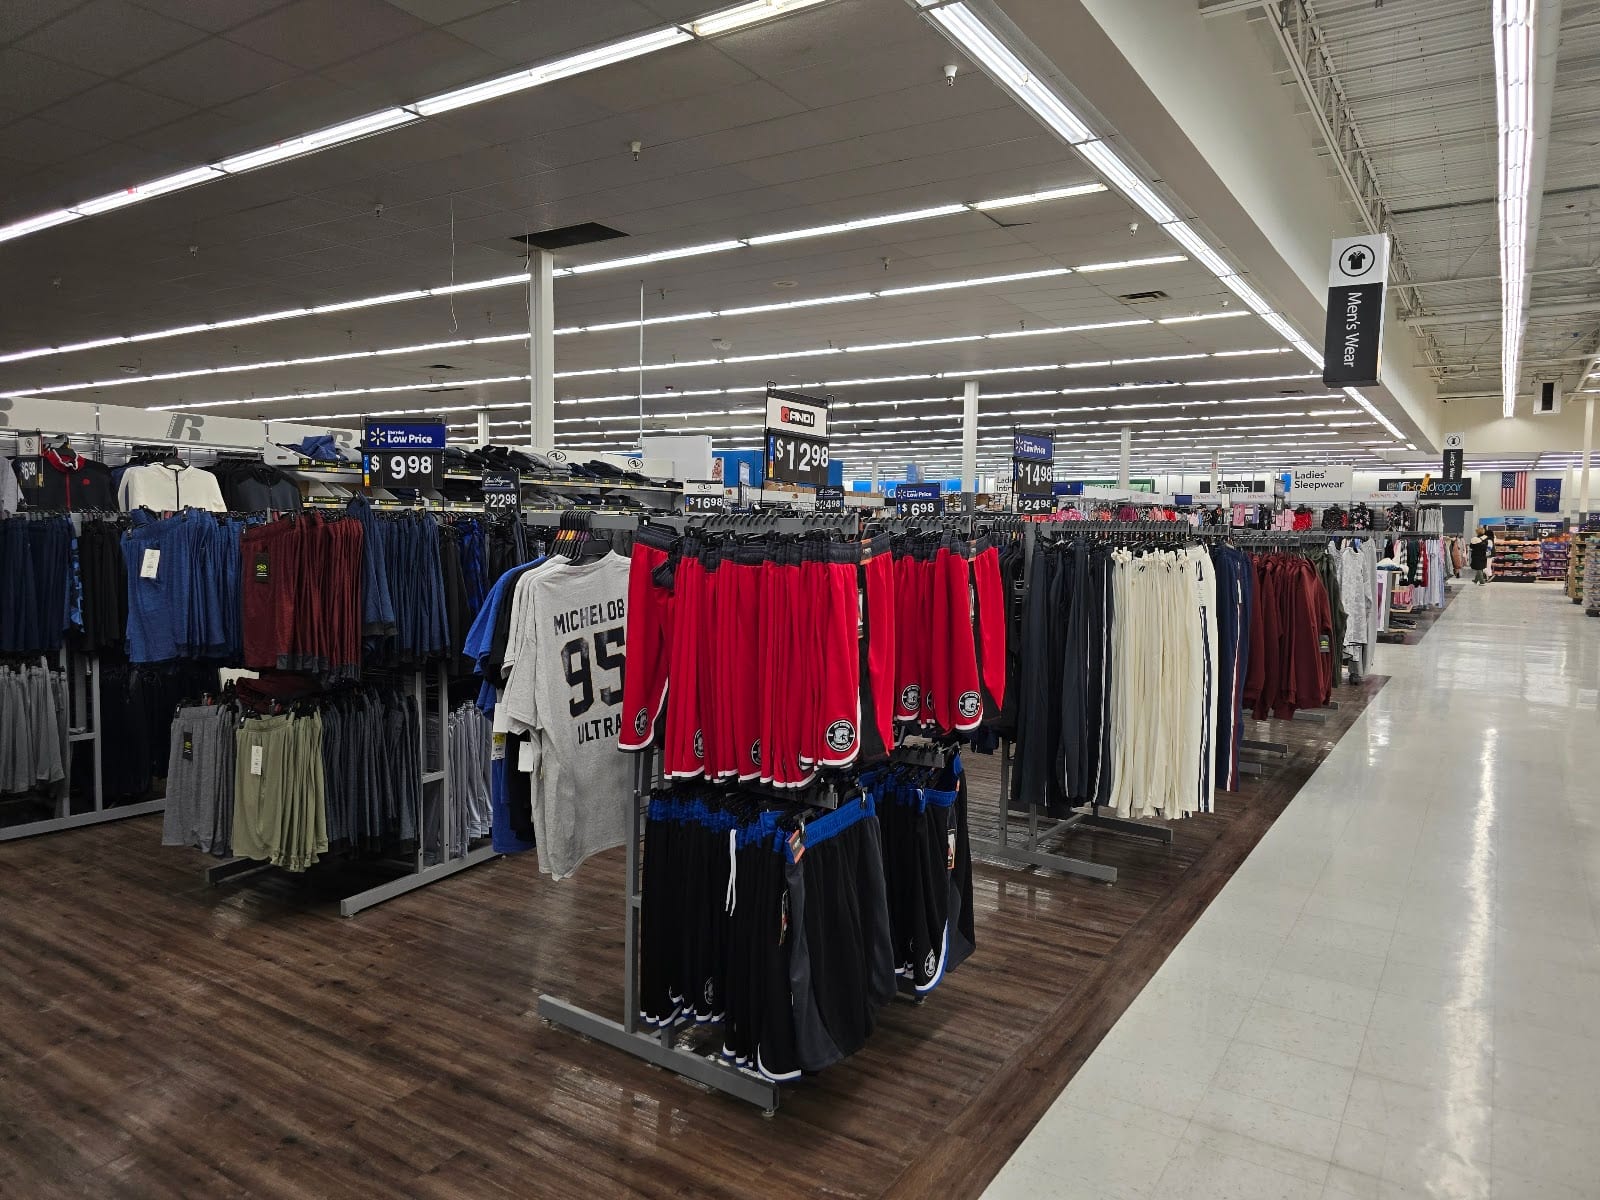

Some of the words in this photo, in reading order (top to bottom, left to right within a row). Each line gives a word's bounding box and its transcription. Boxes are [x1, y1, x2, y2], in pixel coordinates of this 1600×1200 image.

[1346, 292, 1363, 331] Men's
[1343, 332, 1360, 368] Wear
[387, 434, 408, 444] Low
[408, 434, 433, 444] Price
[1294, 470, 1327, 479] Ladies'
[1294, 480, 1344, 491] Sleepwear
[553, 598, 625, 636] MICHELOB
[560, 625, 626, 718] 95
[577, 713, 622, 745] ULTRA
